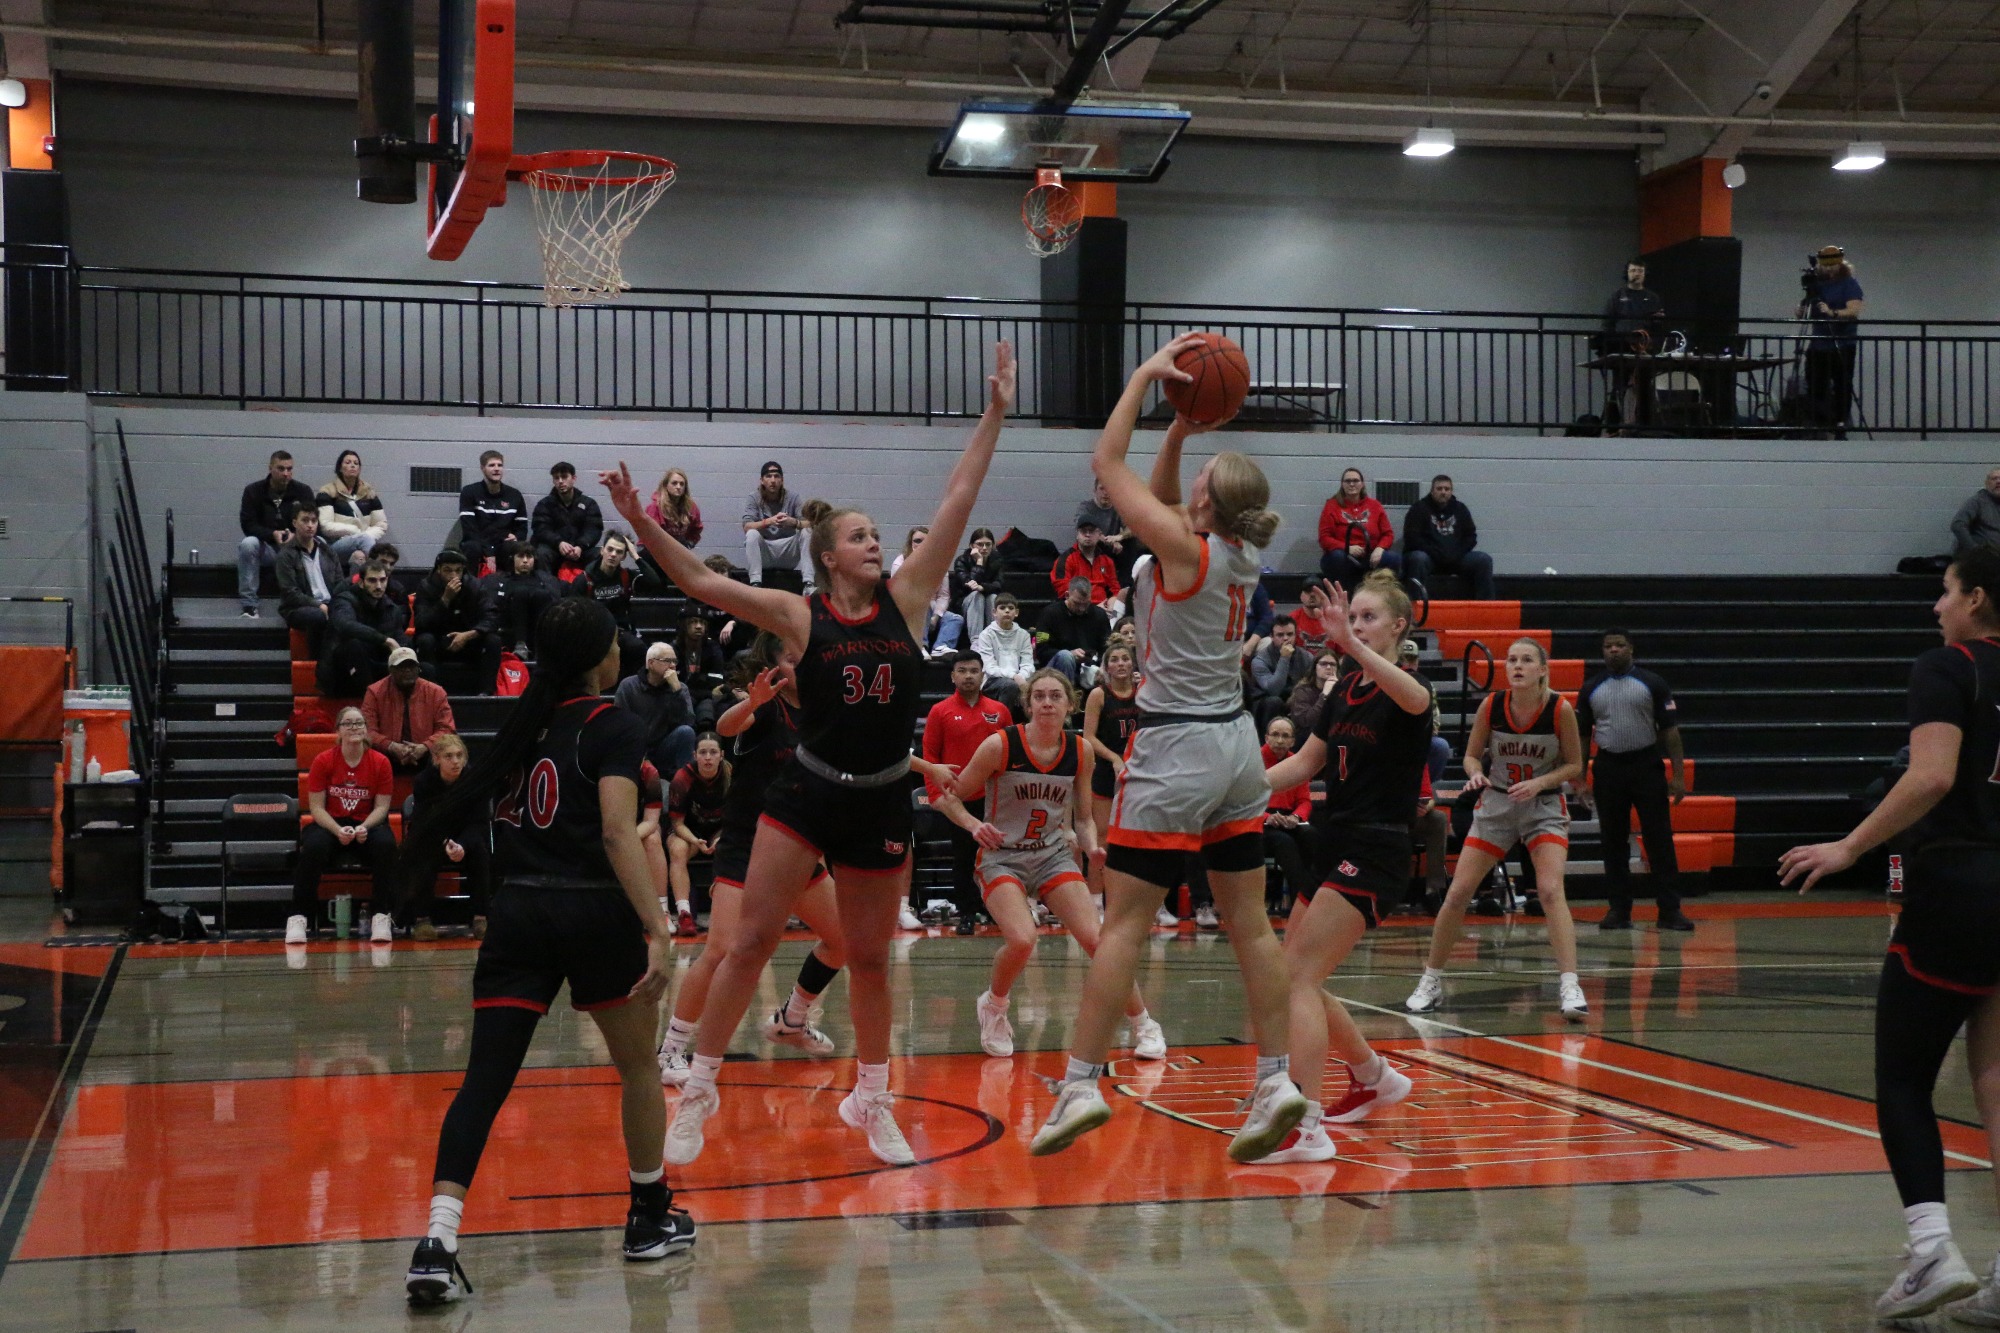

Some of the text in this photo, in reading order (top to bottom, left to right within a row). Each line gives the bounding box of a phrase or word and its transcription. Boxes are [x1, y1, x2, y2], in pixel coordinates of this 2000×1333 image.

[1224, 583, 1246, 641] 11
[821, 639, 911, 662] WARRIORS
[842, 663, 896, 704] 34
[1337, 745, 1348, 781] 1
[1498, 742, 1546, 760] INDIANA
[1506, 762, 1533, 788] 31
[494, 758, 559, 829] 20
[1014, 782, 1067, 804] INDIANA
[1024, 809, 1048, 839] 2
